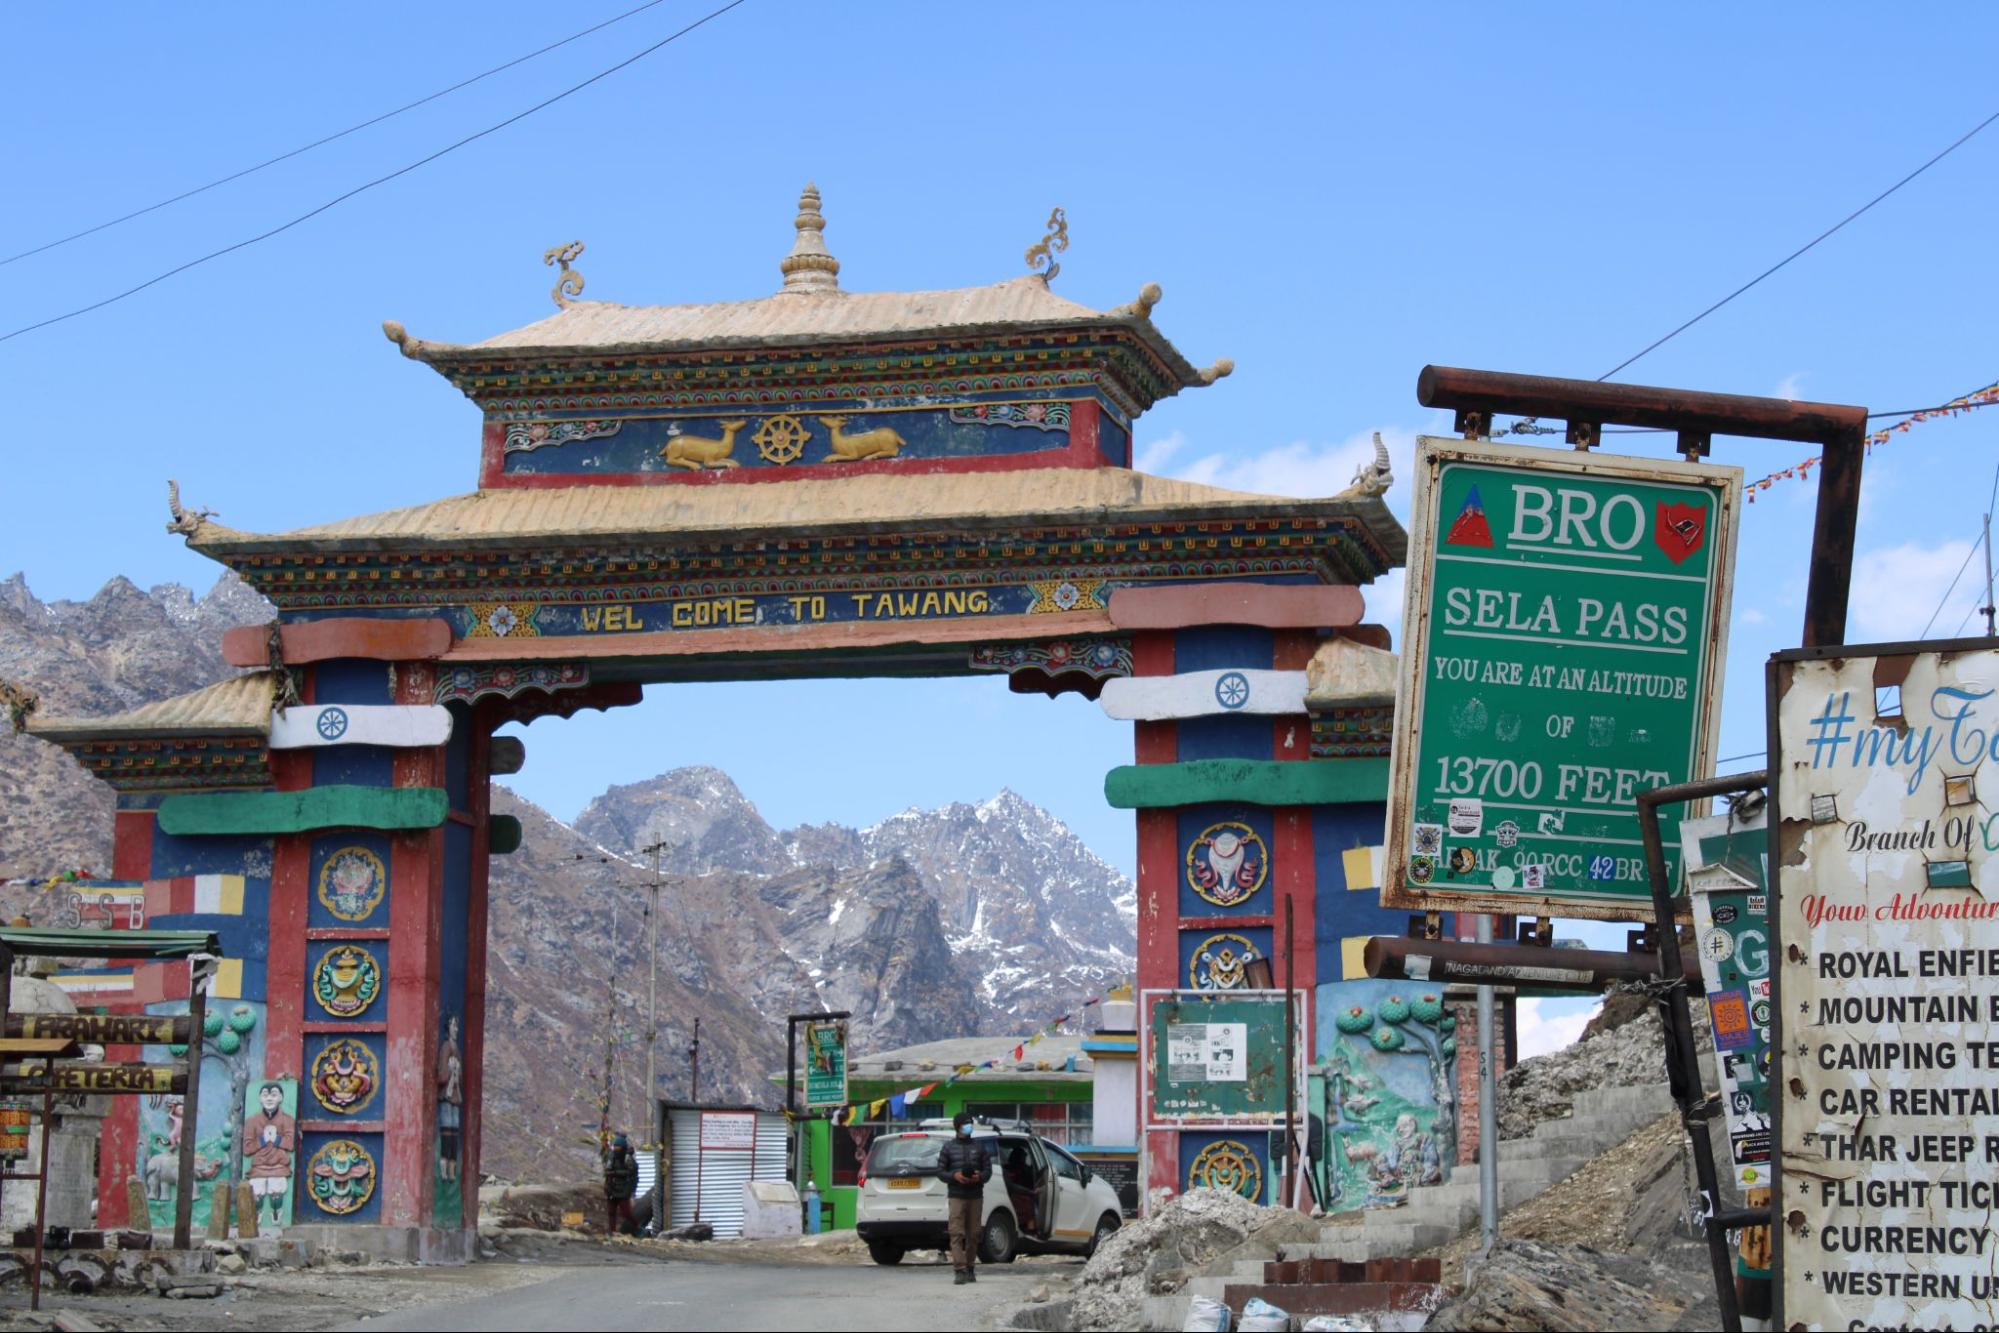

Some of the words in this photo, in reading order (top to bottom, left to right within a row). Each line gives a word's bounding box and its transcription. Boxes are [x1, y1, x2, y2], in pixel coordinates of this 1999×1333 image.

[1508, 484, 1645, 551] BRO
[581, 607, 643, 632] WEL
[672, 599, 755, 627] COME
[788, 596, 826, 621] TO
[851, 589, 988, 618] TAWANG
[1445, 587, 1561, 633] SELA
[1575, 598, 1688, 644] PASS
[1435, 656, 1478, 682] YOU
[1481, 661, 1524, 686] ARE
[1528, 665, 1556, 689] AT
[1557, 667, 1586, 691] AN
[1587, 669, 1688, 699] ALTITUDE
[1545, 714, 1575, 739] OF
[1434, 756, 1543, 800] 13700
[1555, 764, 1671, 806] FEET
[1845, 820, 1936, 852] Branch
[1943, 814, 1976, 853] Of
[1542, 853, 1583, 878] RCC
[1589, 855, 1614, 881] 42
[1819, 952, 1909, 979] ROYAL
[1819, 996, 1978, 1024] MOUNTAIN
[1818, 1042, 1956, 1070] CAMPING
[1820, 1088, 1880, 1116] CAR
[1819, 1134, 1898, 1162] THAR
[1905, 1135, 1975, 1163] JEEP
[1821, 1181, 1930, 1208] FLIGHT
[1820, 1226, 1991, 1255] CURRENCY
[1822, 1271, 1960, 1299] WESTERN
